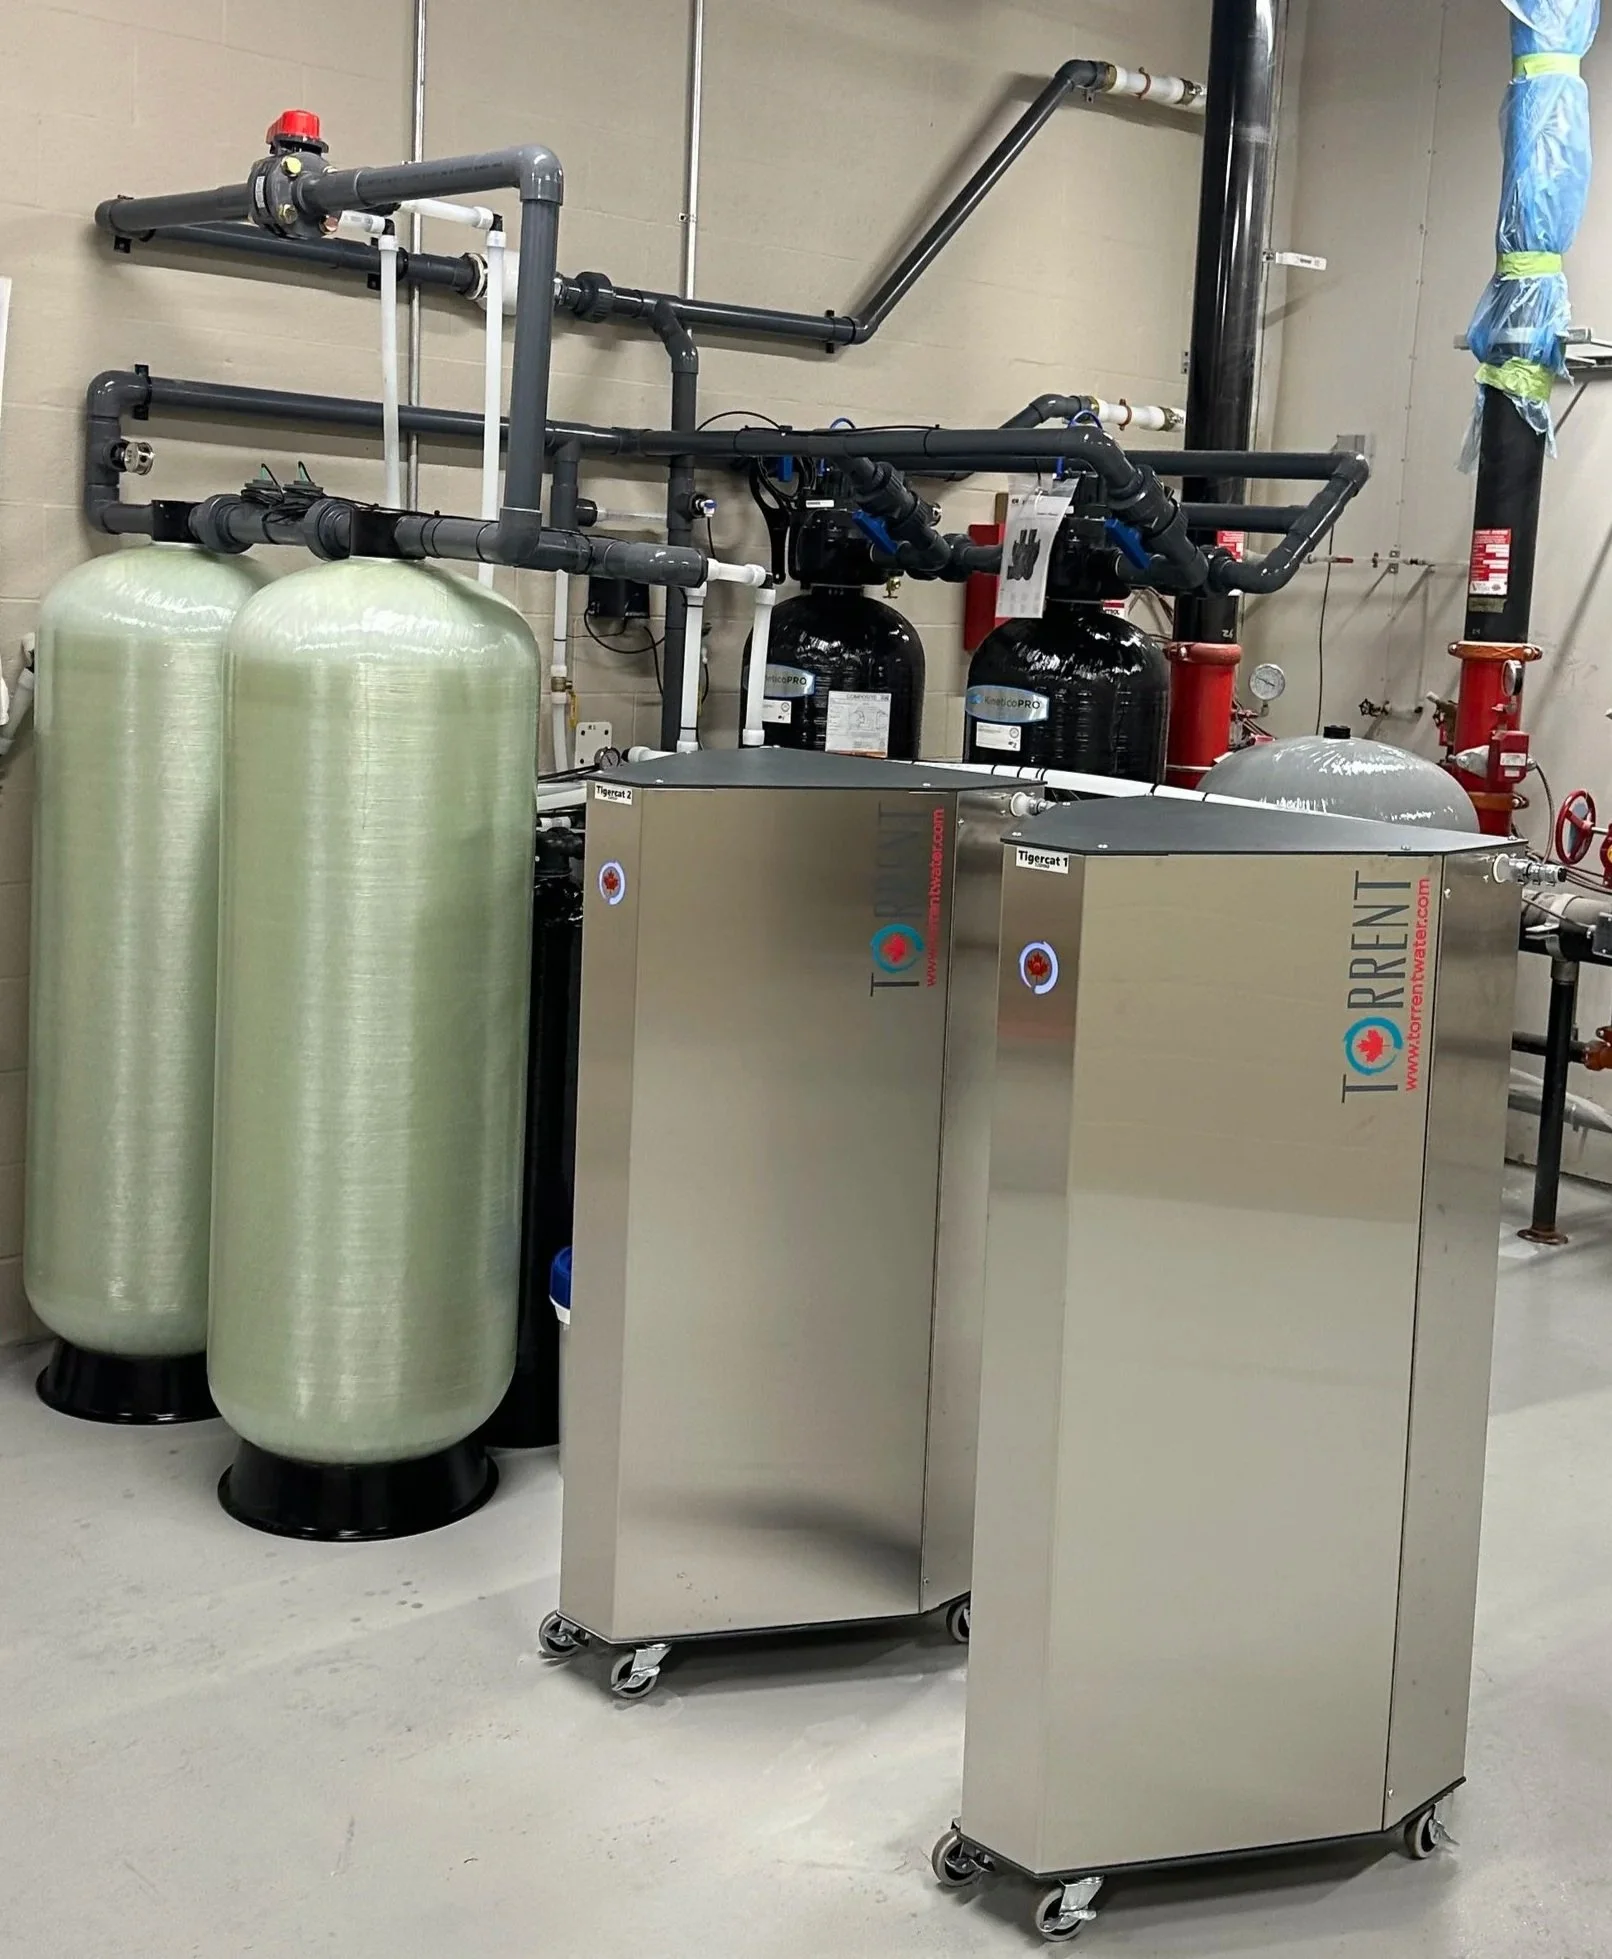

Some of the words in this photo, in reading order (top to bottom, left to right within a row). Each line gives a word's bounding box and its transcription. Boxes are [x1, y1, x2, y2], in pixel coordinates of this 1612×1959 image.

[985, 696, 1041, 710] KineticoPRO
[596, 785, 626, 798] Tigercat
[626, 790, 632, 800] 2
[926, 805, 945, 987] wwwrrentwater.com
[1018, 850, 1061, 866] Tigercat
[1063, 857, 1068, 867] 1
[1341, 870, 1412, 1104] TORRENT
[1405, 879, 1431, 1092] www.torrentwater.com
